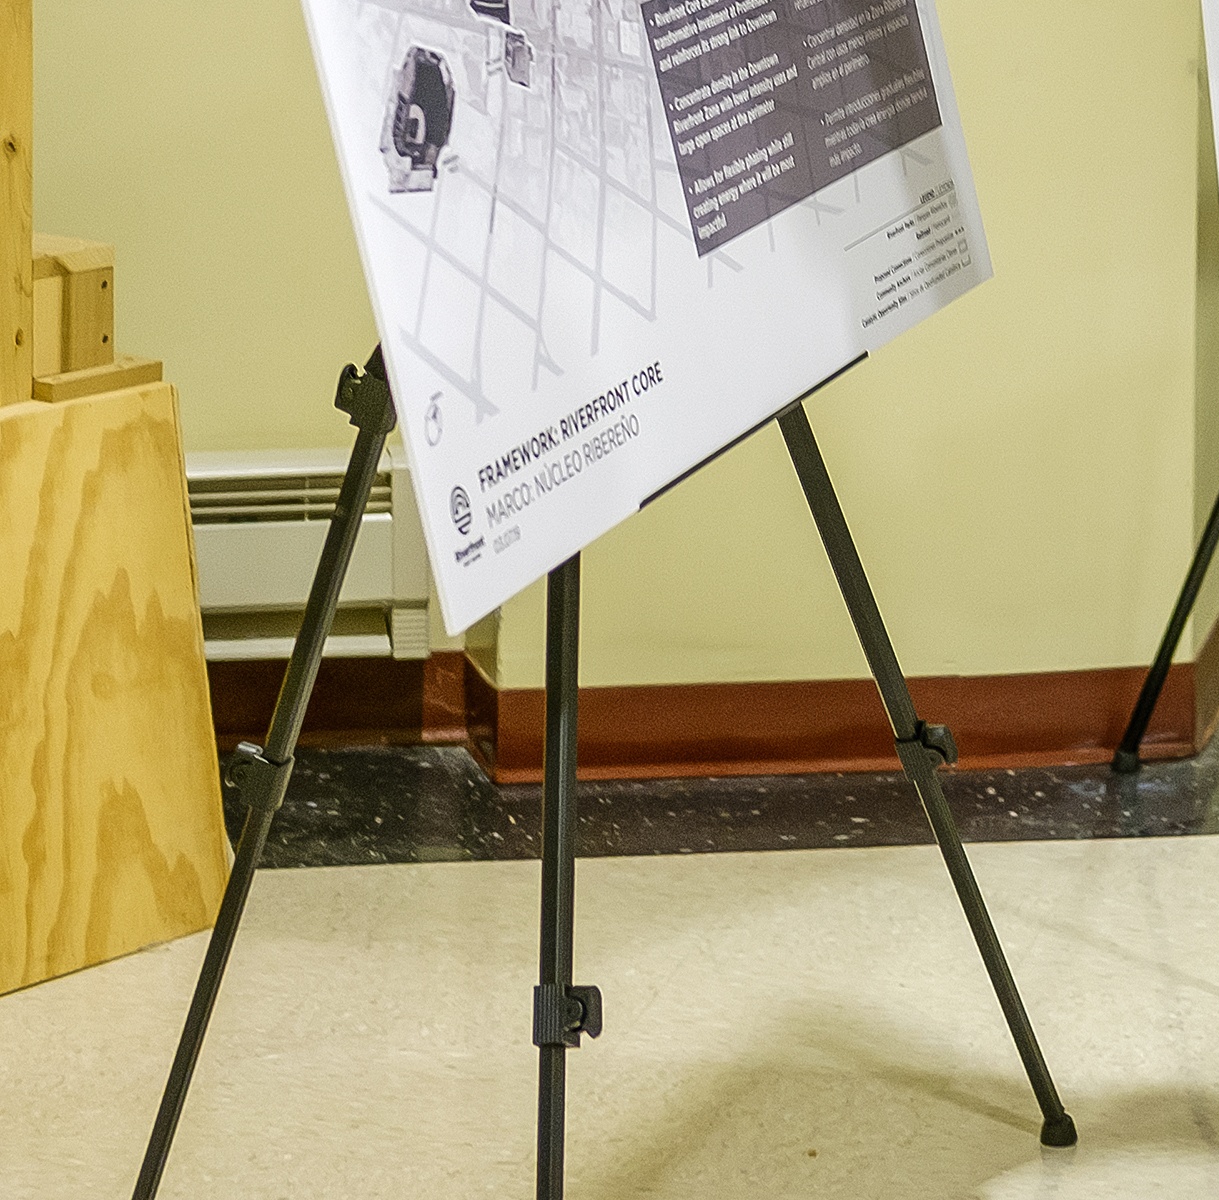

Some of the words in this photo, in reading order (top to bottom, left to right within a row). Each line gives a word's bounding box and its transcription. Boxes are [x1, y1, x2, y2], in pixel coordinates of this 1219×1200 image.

[478, 426, 560, 491] FRAMEWORK:
[559, 380, 630, 440] RIVERFRONT
[632, 361, 663, 396] CORE
[485, 482, 536, 528] MARCO:
[533, 449, 583, 497] NÚCLEO
[582, 414, 639, 467] RIBEREÑO
